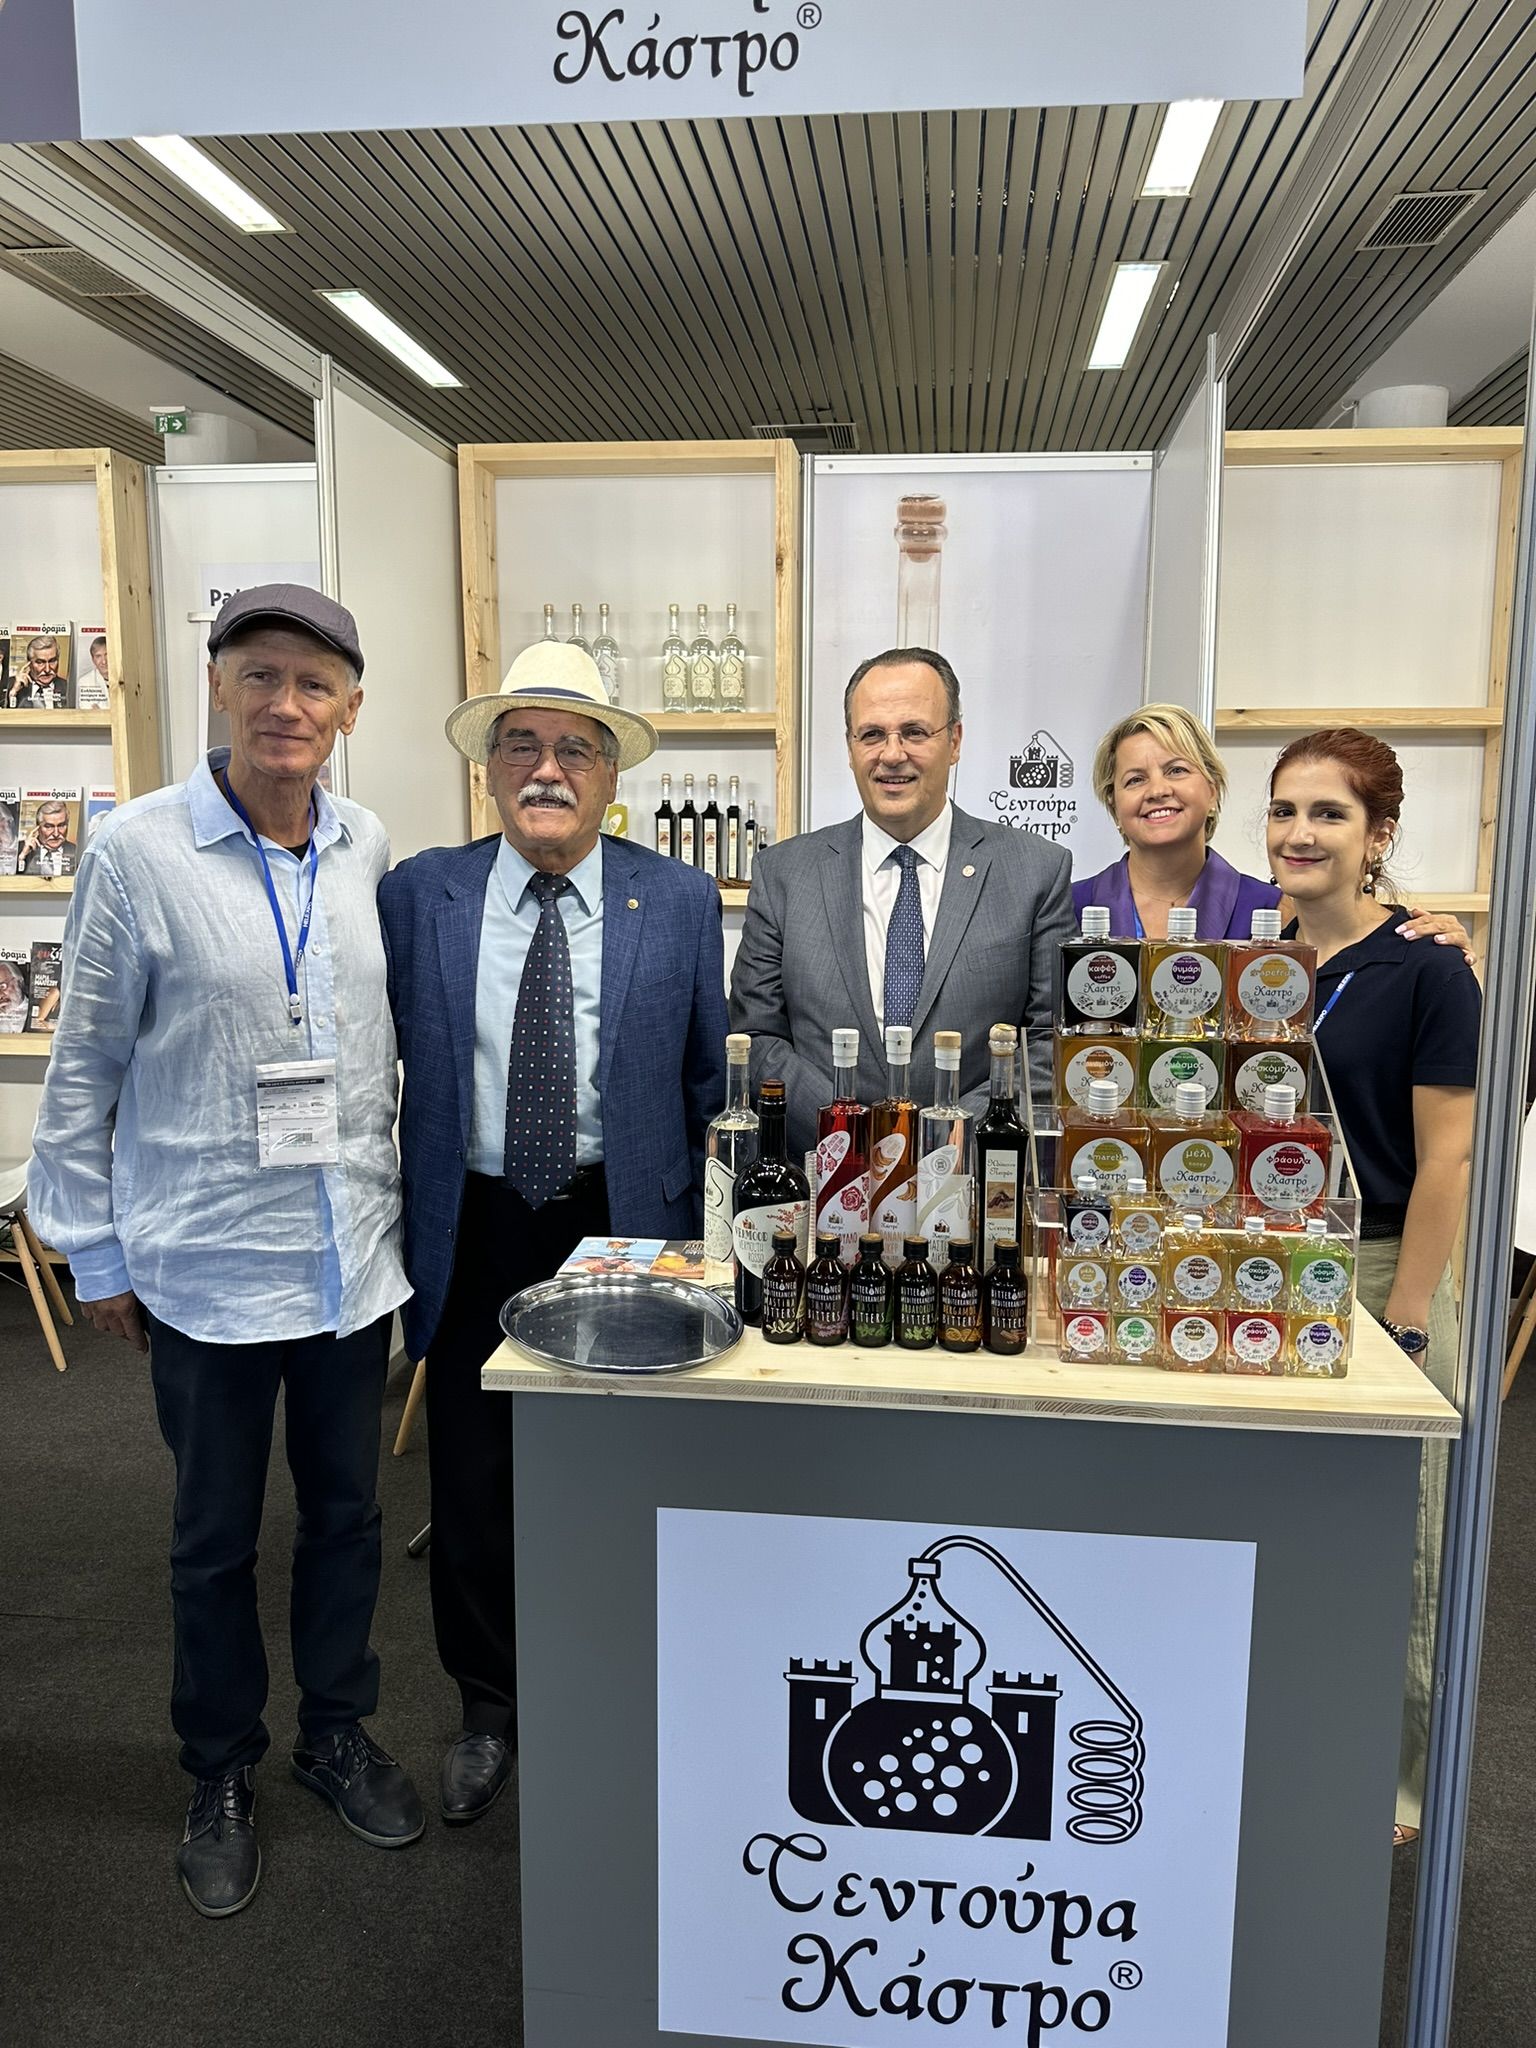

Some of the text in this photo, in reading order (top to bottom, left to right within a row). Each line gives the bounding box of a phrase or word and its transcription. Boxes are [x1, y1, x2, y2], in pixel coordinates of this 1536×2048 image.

[553, 9, 799, 97] Κάστρο
[989, 790, 1076, 818] Τεντούρα
[742, 1833, 1139, 1964] Τεντούρα
[781, 1933, 1112, 2048] Κάστρο
